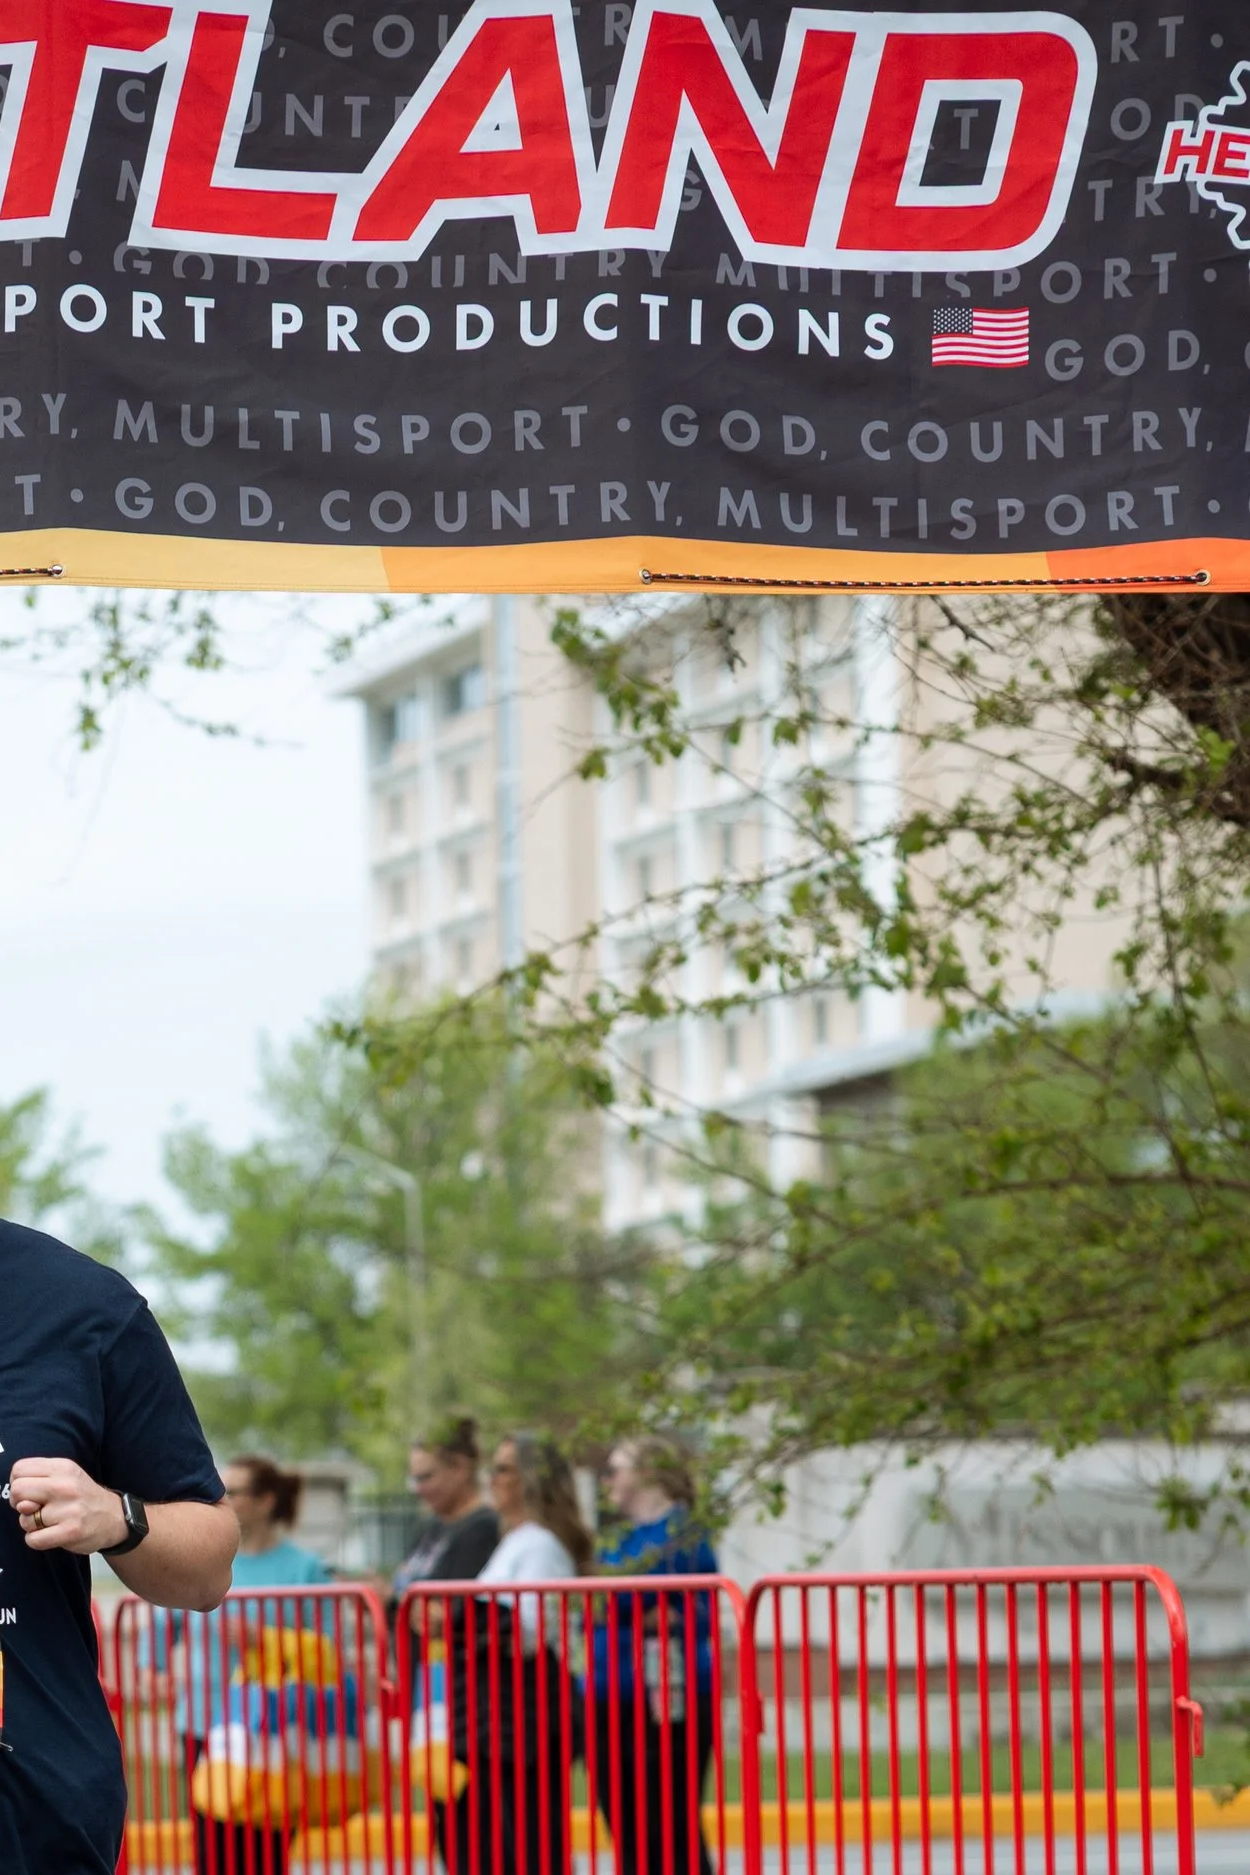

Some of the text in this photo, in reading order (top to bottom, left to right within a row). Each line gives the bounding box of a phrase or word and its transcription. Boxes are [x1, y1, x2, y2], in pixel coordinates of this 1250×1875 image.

[271, 293, 894, 360] PRODUCTIONS
[1044, 330, 1210, 382] GOD,
[112, 399, 592, 456] MULTISPORT
[660, 404, 828, 461] GOD,
[859, 407, 1213, 464] COUNTRY,
[114, 476, 286, 534] GOD,
[319, 480, 683, 534] COUNTRY,
[717, 485, 1181, 540] MULTISPORT
